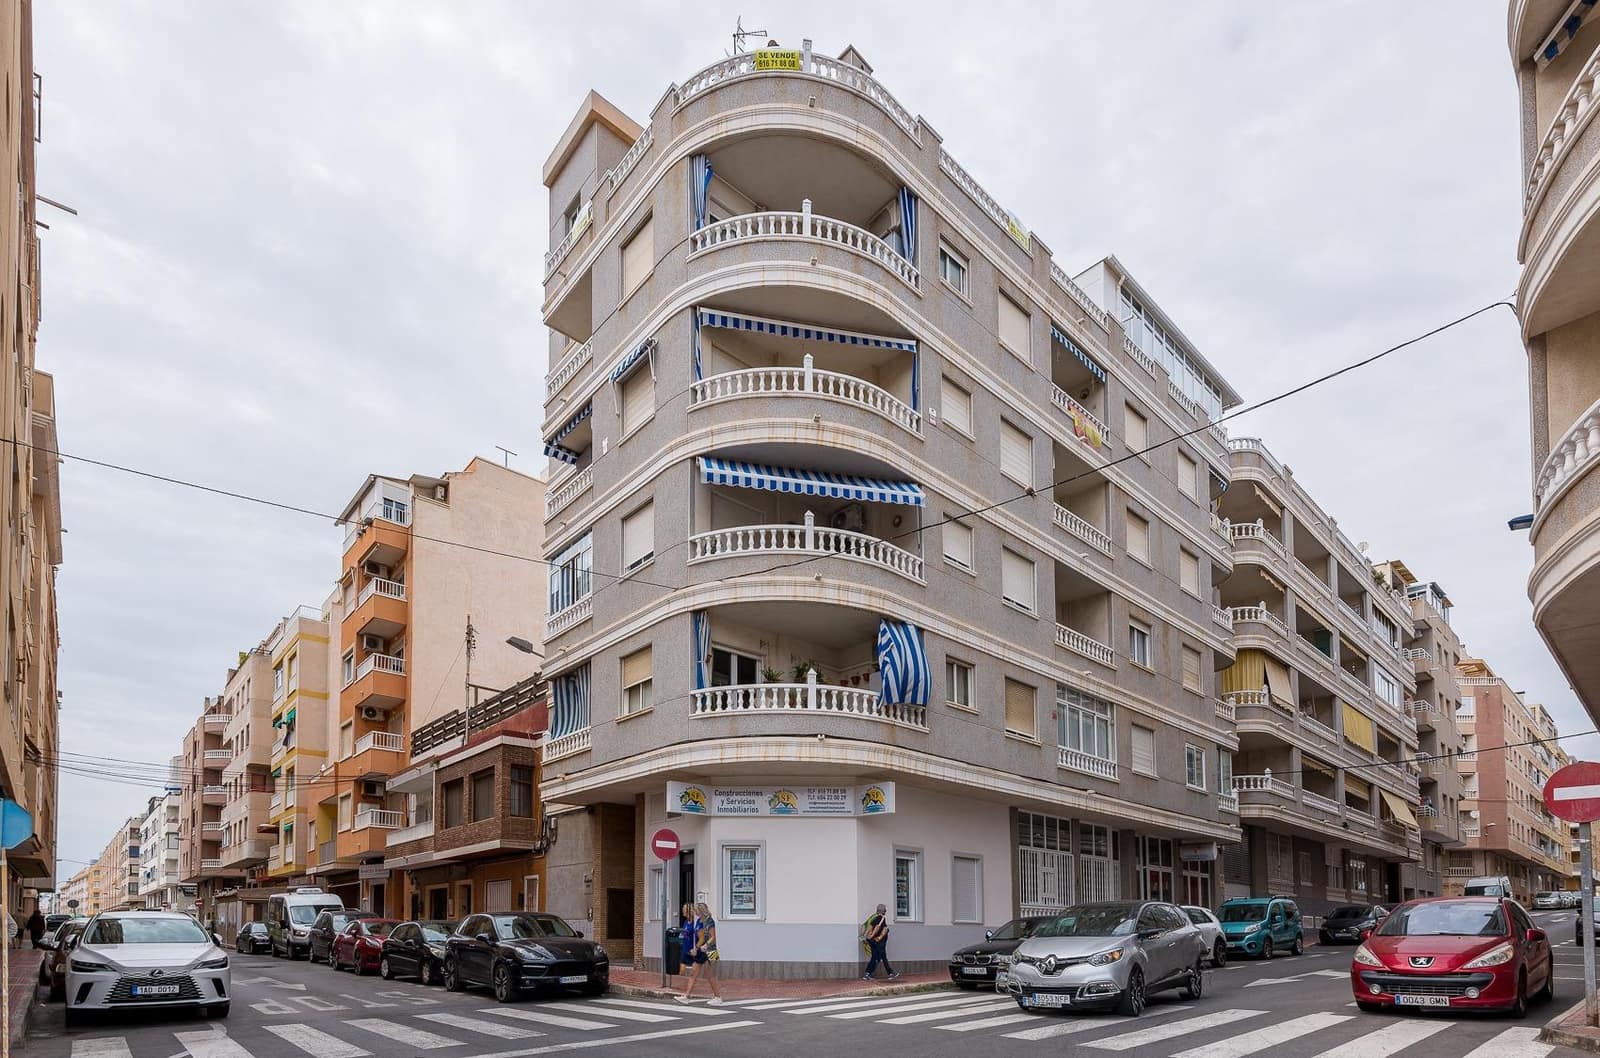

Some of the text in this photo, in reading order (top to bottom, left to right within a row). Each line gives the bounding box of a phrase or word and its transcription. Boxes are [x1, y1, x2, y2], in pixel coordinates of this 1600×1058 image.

[771, 60, 778, 68] 71
[714, 789, 763, 797] Construcciones
[726, 797, 756, 805] Servicios
[717, 805, 759, 813] Inmobiliarios
[248, 991, 444, 1015] STOP
[1402, 996, 1448, 1005] 0043 GMN
